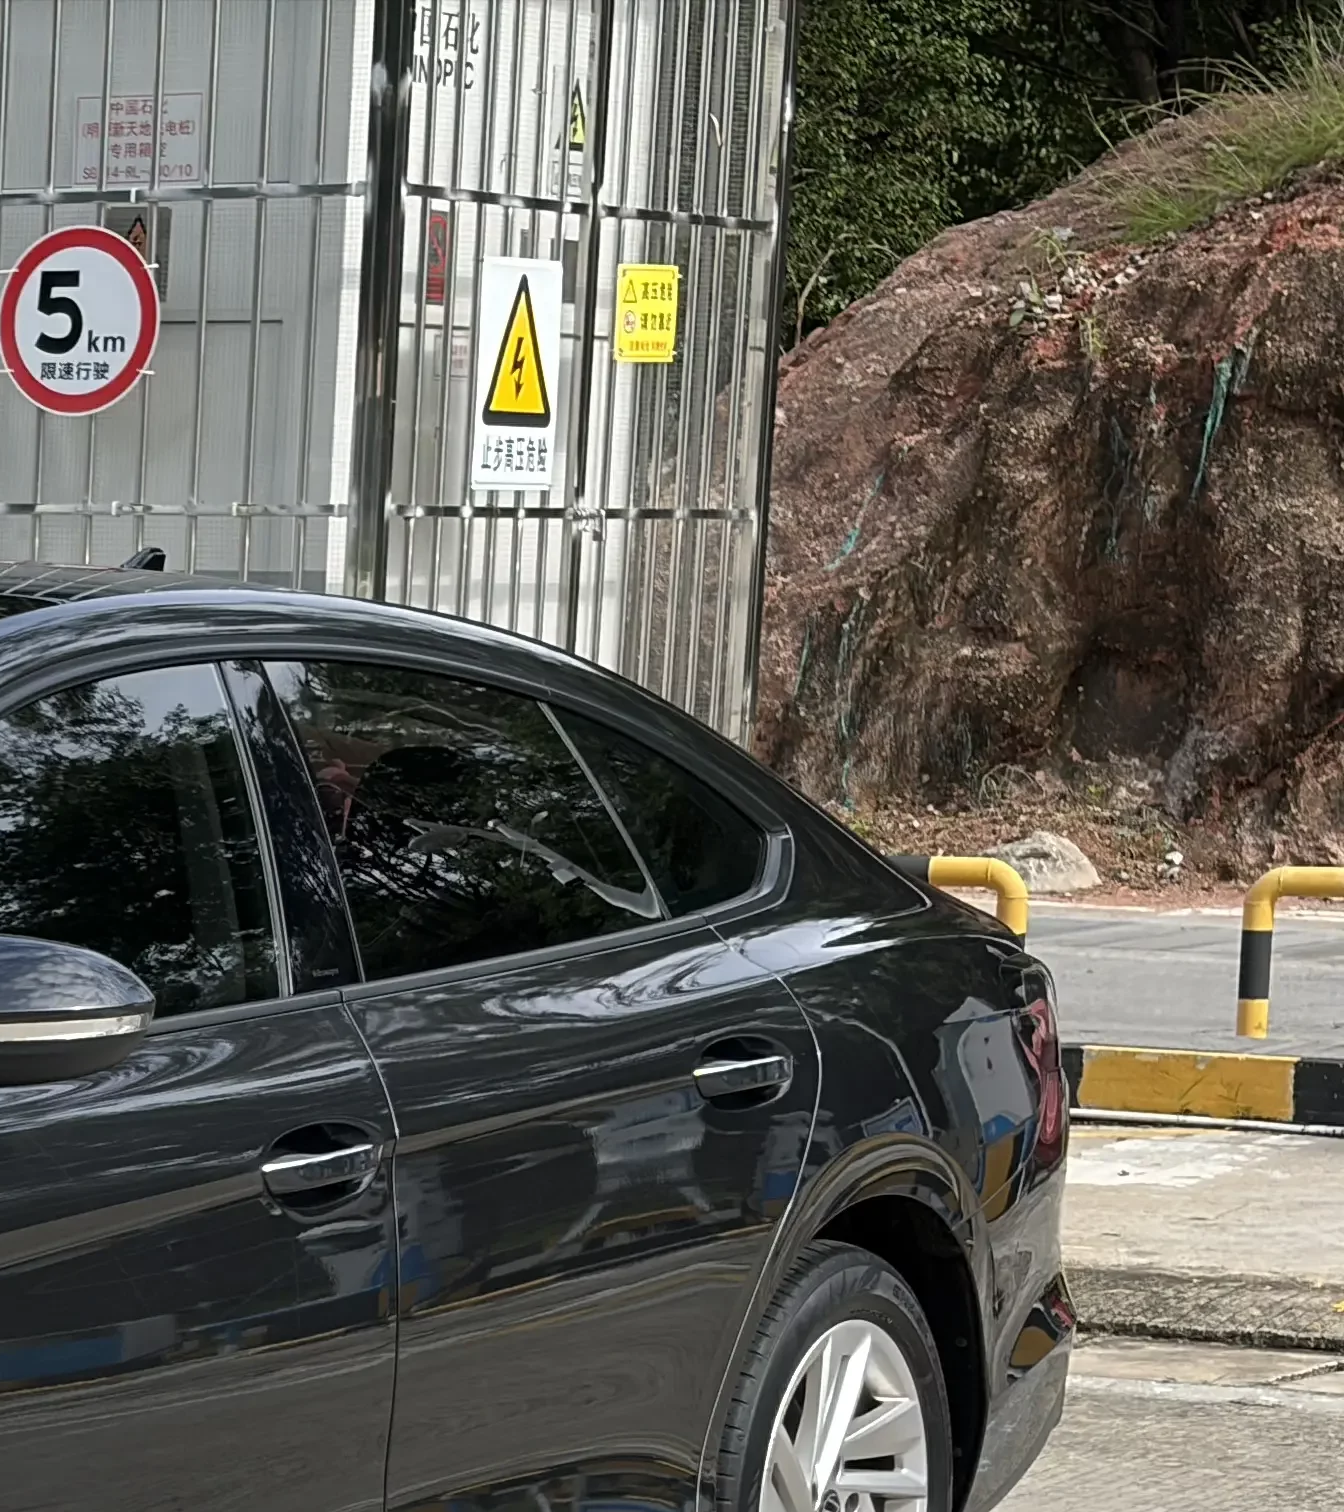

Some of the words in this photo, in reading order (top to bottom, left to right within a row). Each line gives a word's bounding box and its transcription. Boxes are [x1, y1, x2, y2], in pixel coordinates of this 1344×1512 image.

[34, 270, 83, 355] 5
[88, 330, 126, 353] km
[40, 362, 110, 381] 限速行驶
[481, 436, 548, 472] 止步高压危险
